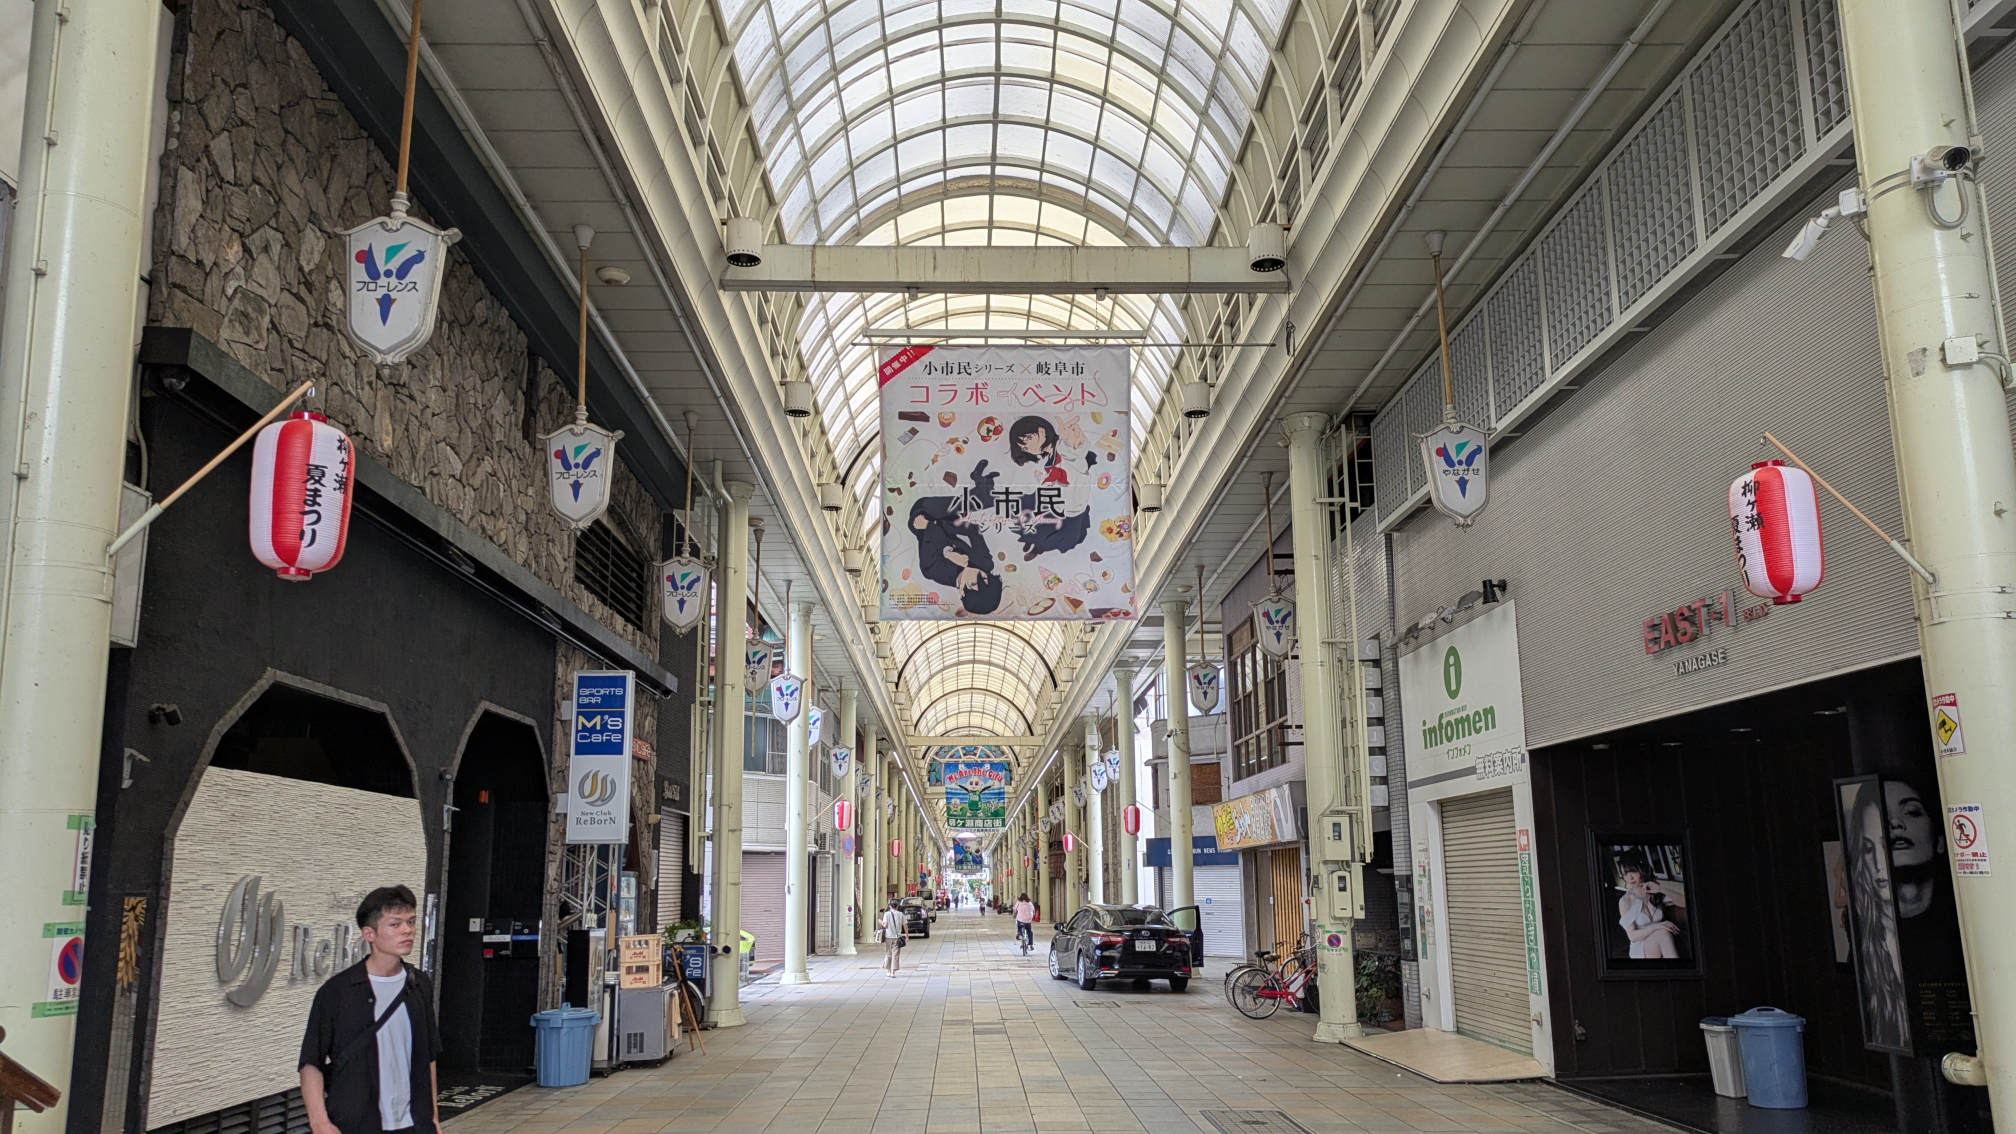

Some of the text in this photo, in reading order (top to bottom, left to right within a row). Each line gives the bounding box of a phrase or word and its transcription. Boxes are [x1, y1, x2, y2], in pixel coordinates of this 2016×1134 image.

[356, 280, 419, 293] フローレンス
[555, 470, 599, 481] フローレンス
[1442, 467, 1481, 477] やながせ
[299, 463, 328, 549] 夏まつり
[948, 486, 1066, 519] 小市民
[980, 522, 1037, 534] シリーズ
[666, 590, 699, 598] フローレンス
[1672, 649, 1728, 676] YANAGASE
[580, 688, 624, 696] SPORTS
[1423, 705, 1497, 750] infomen
[577, 732, 622, 743] Cafe
[958, 769, 972, 777] Are
[973, 767, 986, 776] The
[576, 816, 616, 825] ReBorN
